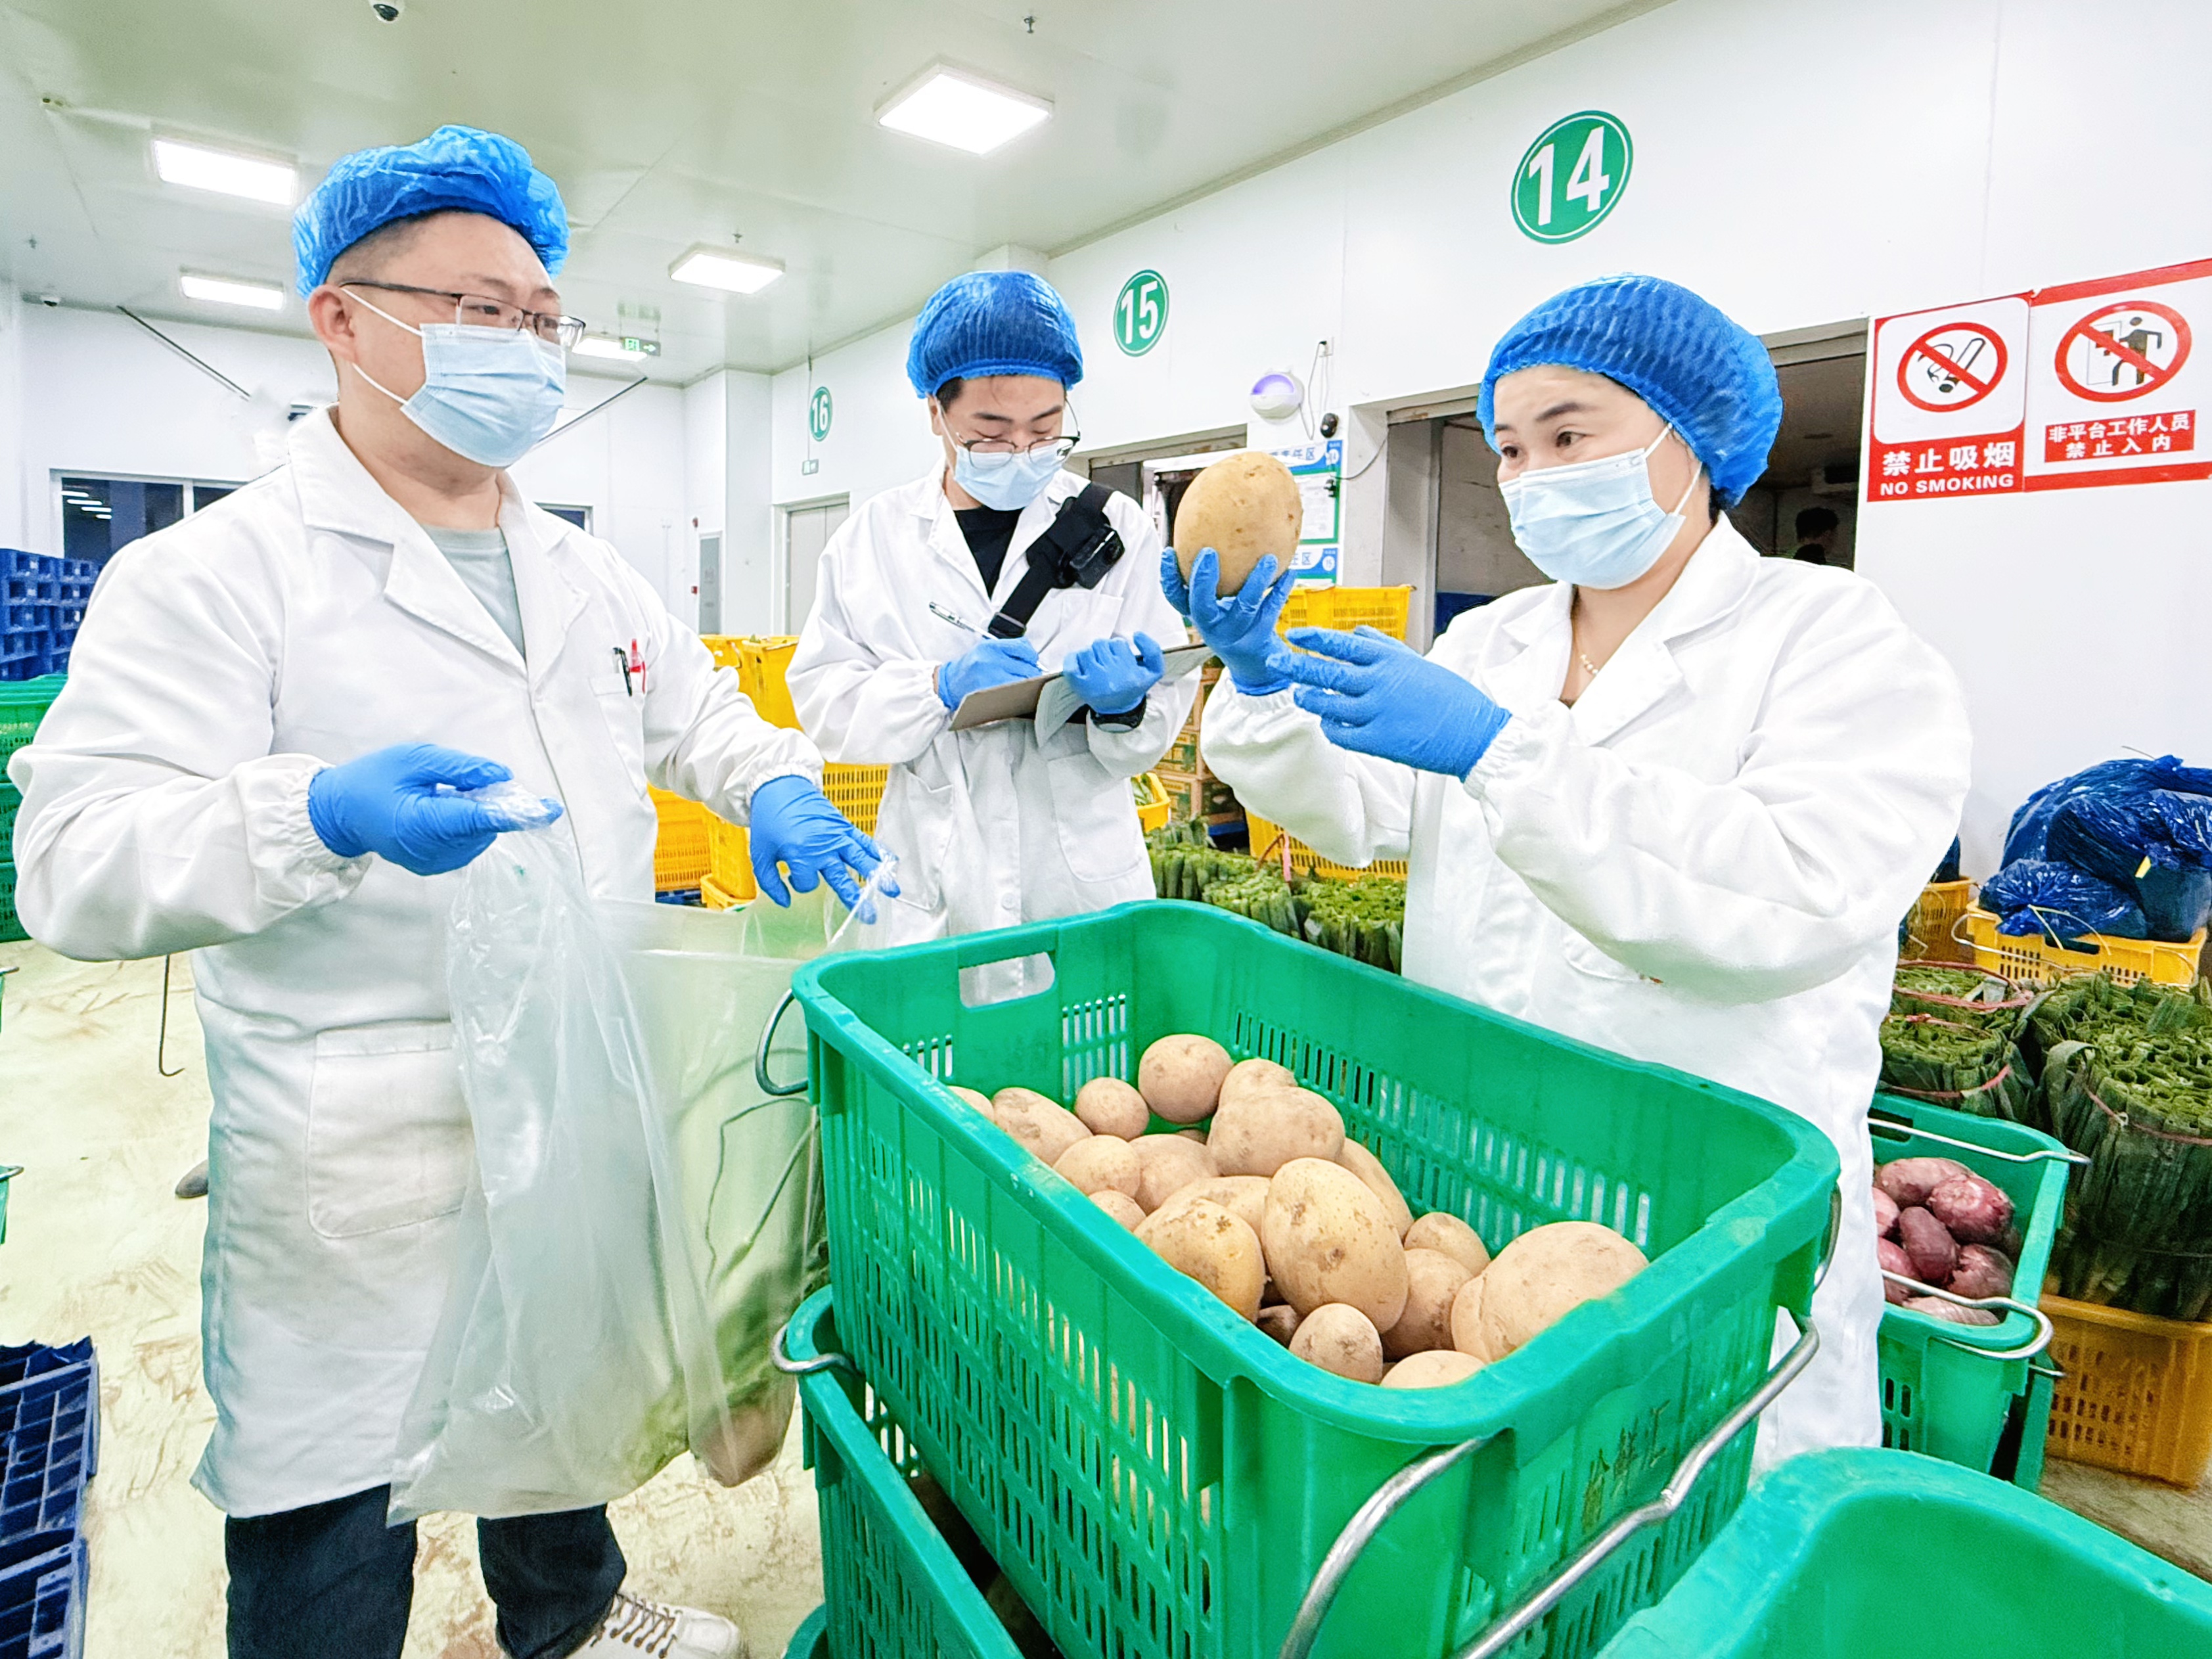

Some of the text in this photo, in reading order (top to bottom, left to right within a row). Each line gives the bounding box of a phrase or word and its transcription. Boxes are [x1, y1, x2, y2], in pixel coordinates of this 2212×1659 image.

[1528, 125, 1610, 226] 14
[1121, 280, 1158, 344] 15
[813, 394, 828, 433] 16
[2048, 413, 2190, 443] 非平台工作人员
[1882, 441, 2016, 476] 禁止吸烟
[2065, 433, 2171, 459] 禁止入内
[1880, 473, 2014, 496] NO SMOKING
